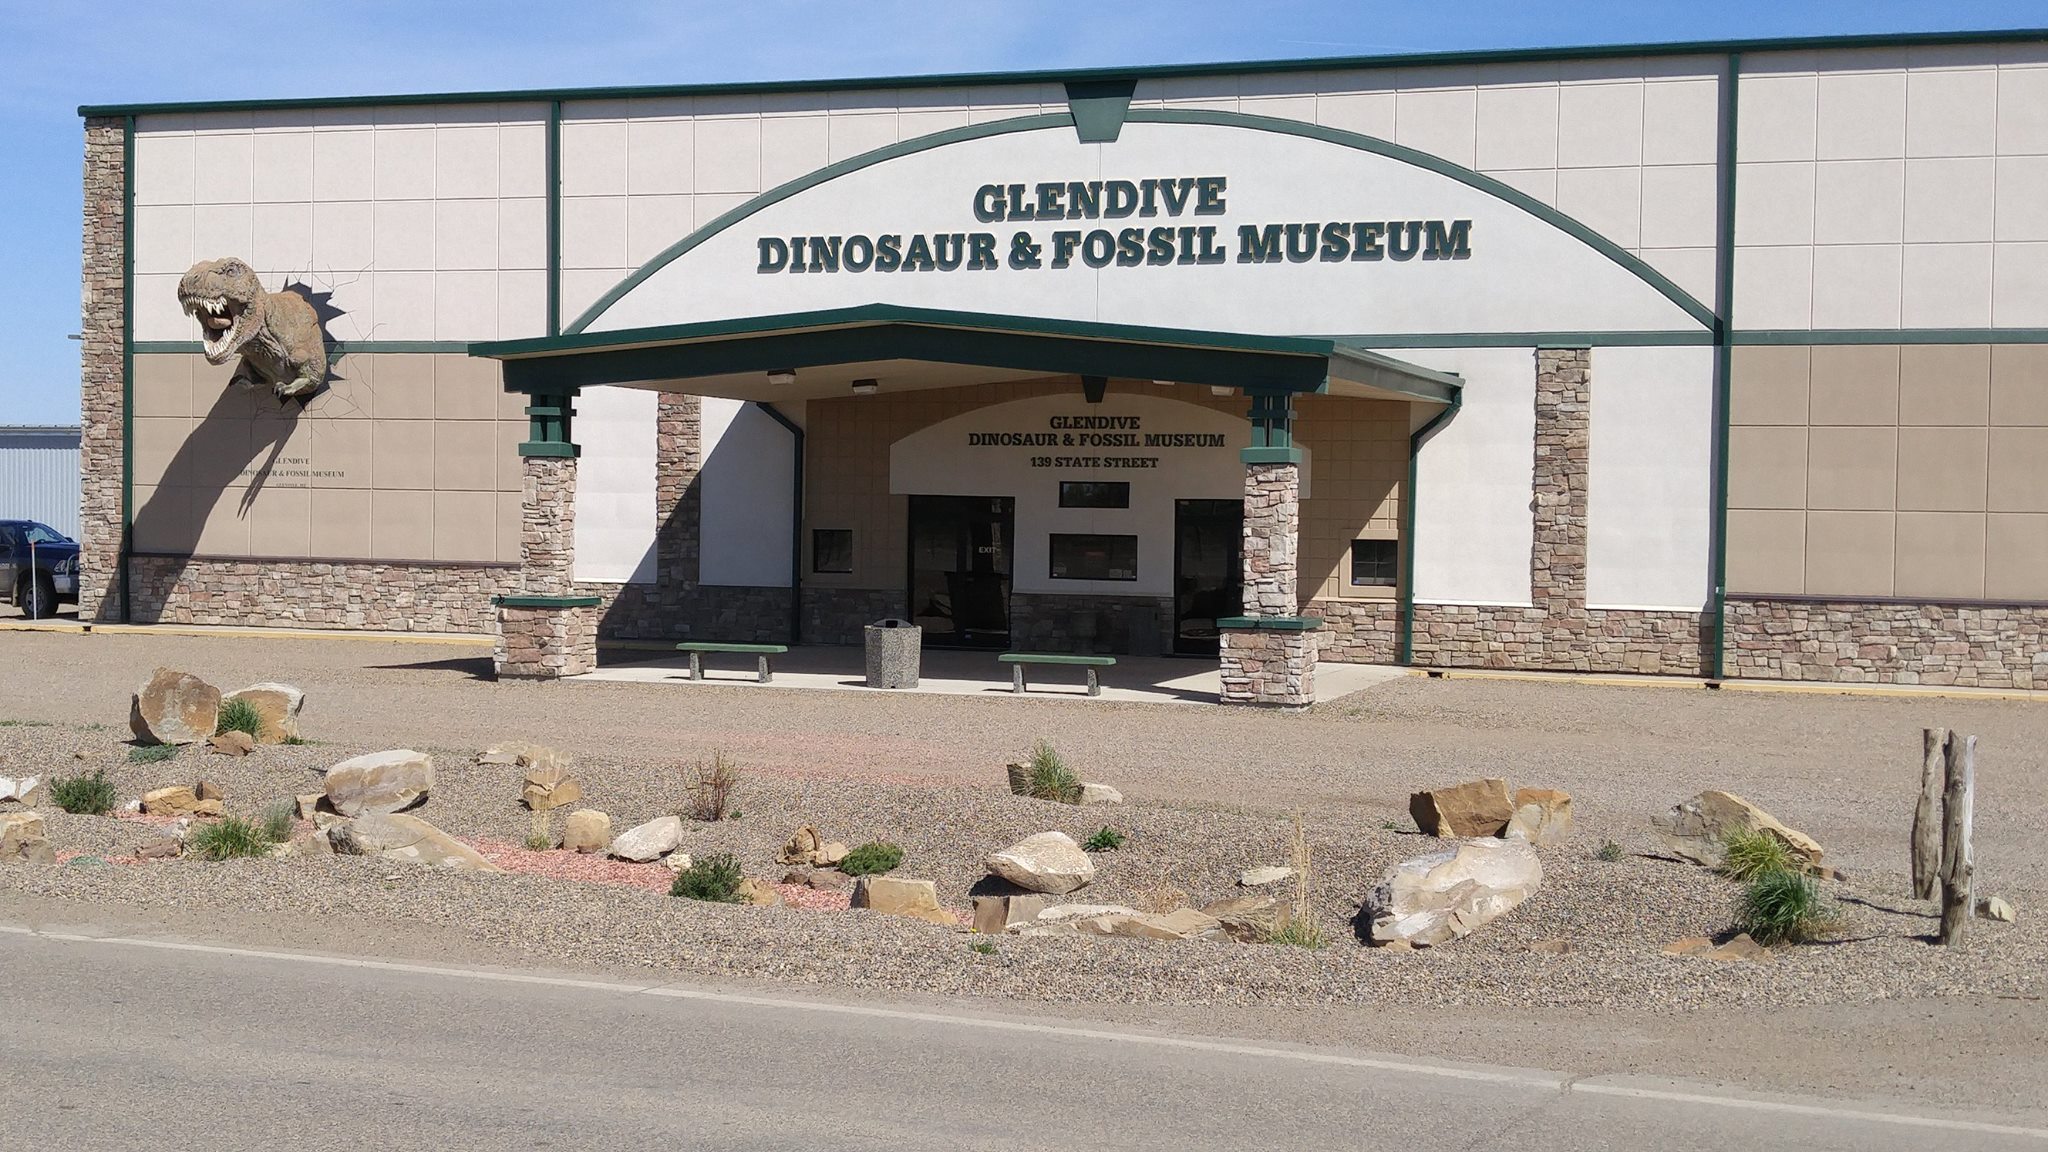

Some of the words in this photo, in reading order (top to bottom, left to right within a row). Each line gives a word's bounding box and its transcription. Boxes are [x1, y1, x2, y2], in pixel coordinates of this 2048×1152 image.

[973, 176, 1227, 223] GLENDIVE
[757, 232, 998, 274] DINOSAUR
[1008, 231, 1042, 269] &
[1051, 226, 1226, 269] FOSSIL
[1237, 220, 1472, 263] MUSEUM
[1050, 416, 1140, 430] GLENDIVE
[968, 432, 1057, 447] DINOSAUR
[1063, 434, 1075, 447] &
[1079, 434, 1140, 447] FOSSIL
[1145, 434, 1225, 448] MUSEUM
[1030, 456, 1051, 468] 139
[1054, 457, 1100, 469] STATE
[1103, 457, 1159, 469] STREET
[278, 470, 285, 478] &
[312, 470, 345, 478] MUSEUM
[979, 546, 997, 554] EXIT
